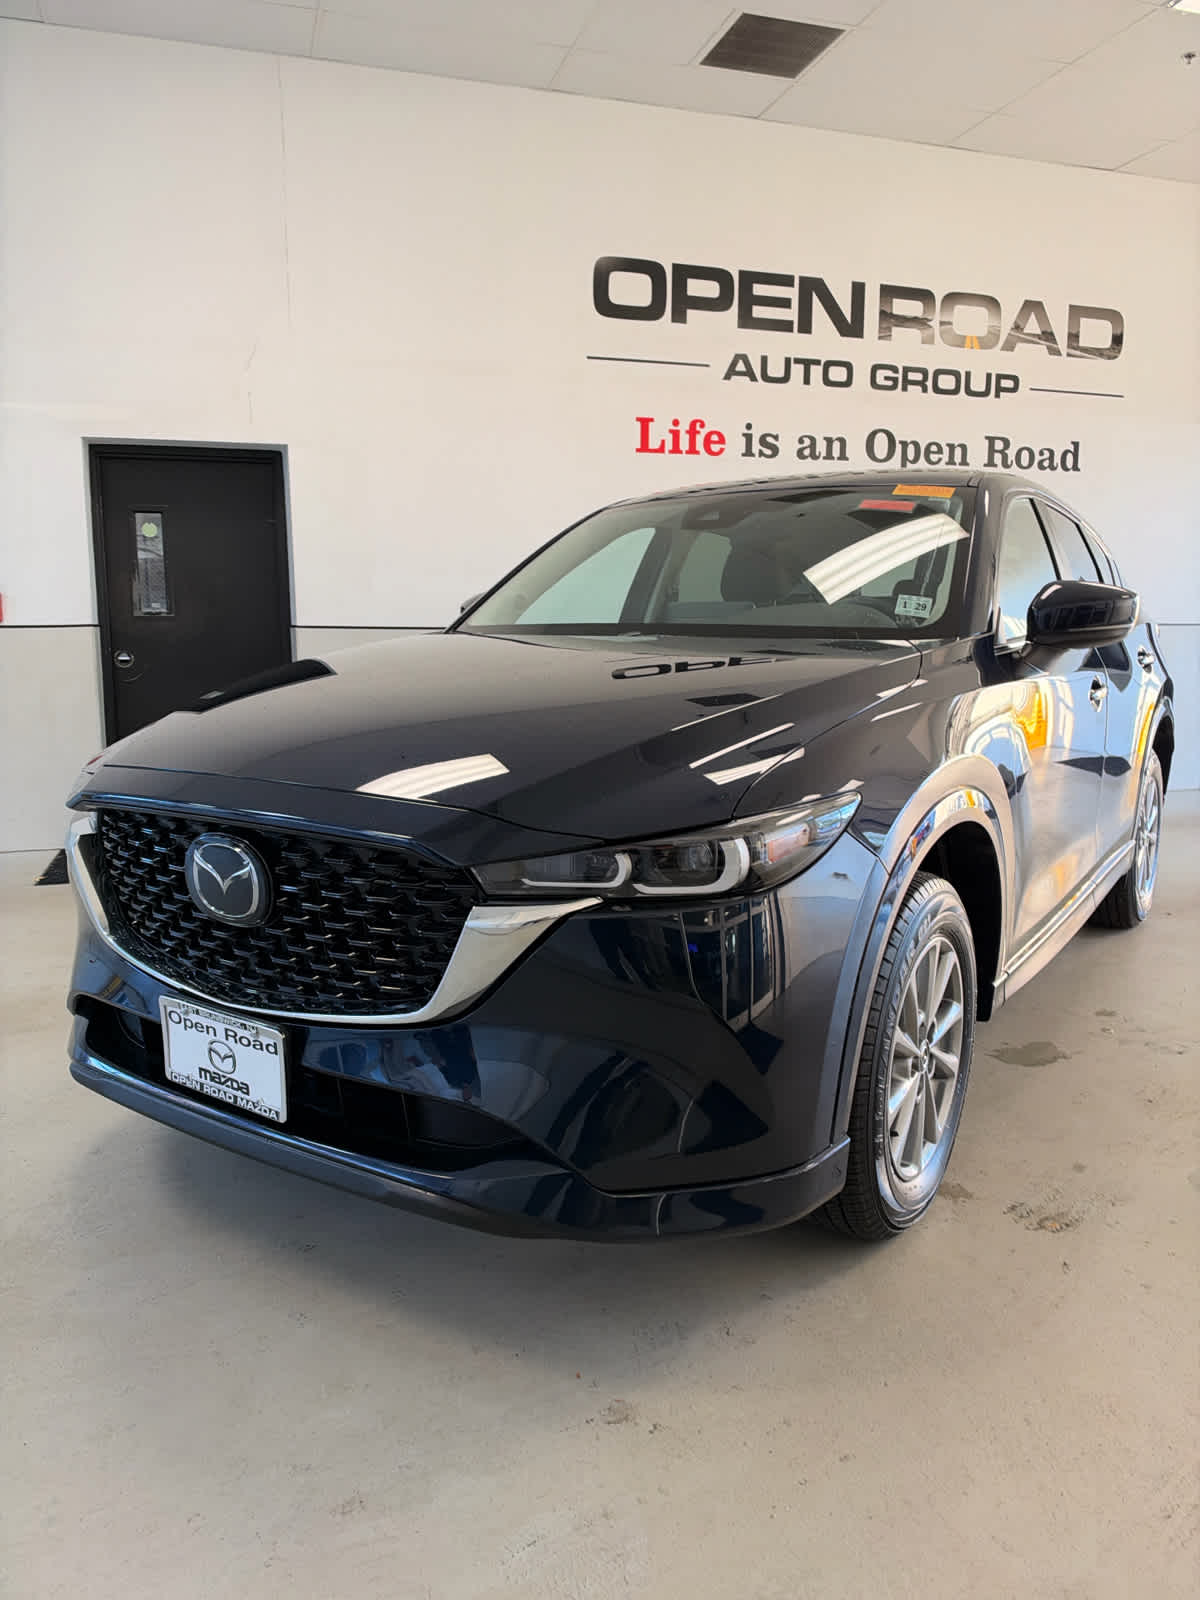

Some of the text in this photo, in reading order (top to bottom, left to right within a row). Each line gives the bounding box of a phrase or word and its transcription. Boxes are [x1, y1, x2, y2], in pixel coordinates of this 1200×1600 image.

[722, 353, 1021, 399] AUTO GROUP
[635, 416, 1081, 472] Life is an Open Road
[168, 1009, 218, 1038] Open
[224, 1027, 279, 1056] Road
[170, 1071, 280, 1121] OPEN ROAD MAZDA
